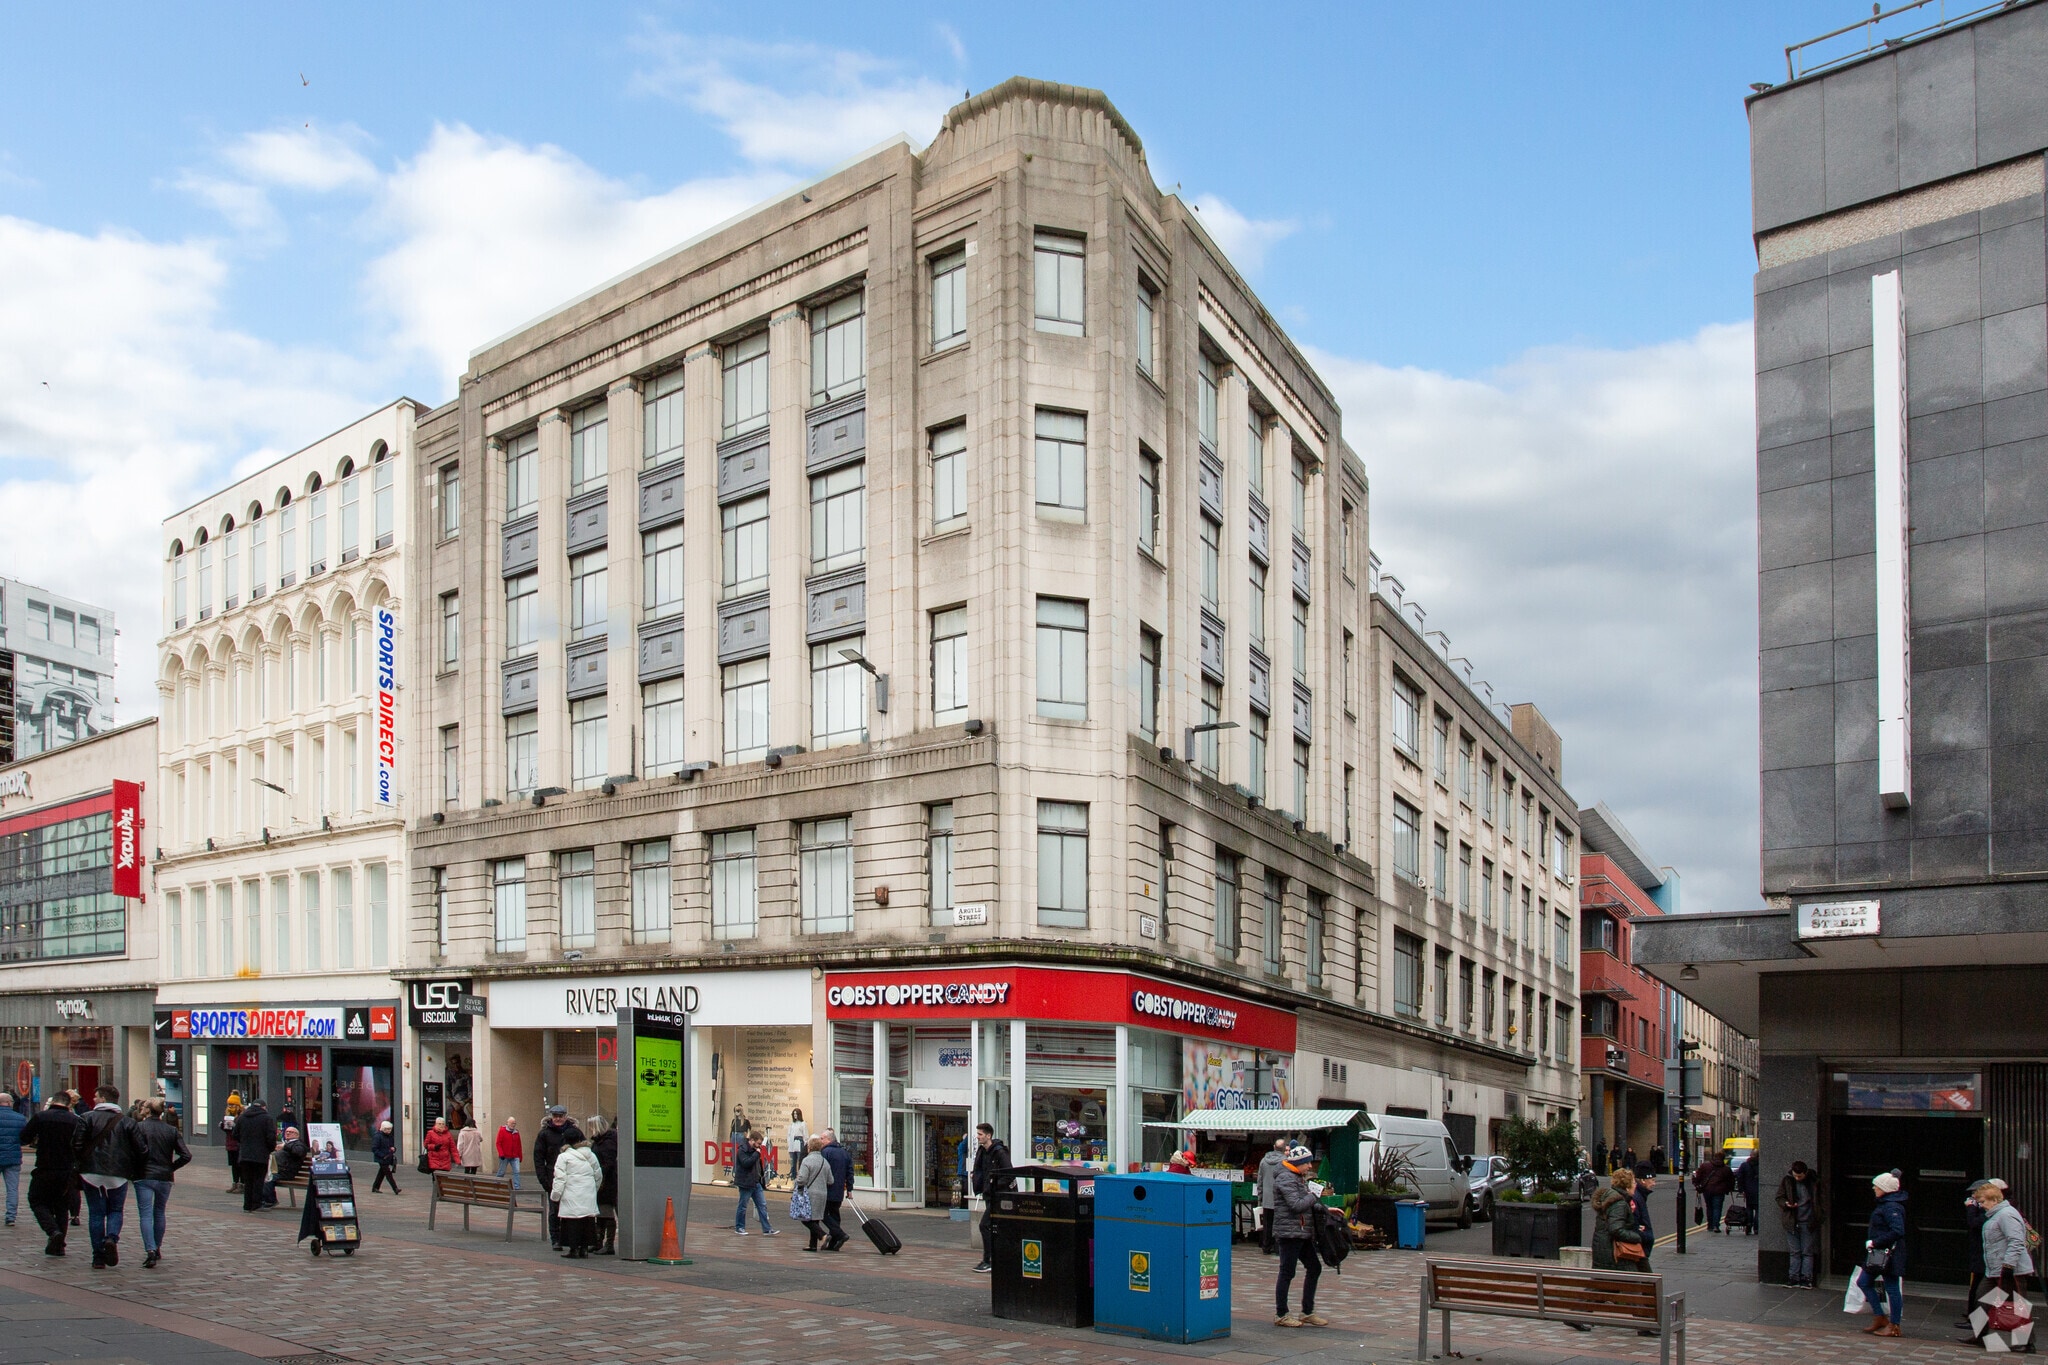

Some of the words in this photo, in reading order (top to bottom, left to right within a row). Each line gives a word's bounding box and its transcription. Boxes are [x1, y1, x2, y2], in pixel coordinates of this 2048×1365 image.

[1811, 906, 1867, 918] ARGYLE
[1811, 918, 1866, 929] STREET
[413, 982, 463, 1009] USC
[565, 987, 618, 1015] RIVER
[627, 986, 700, 1012] ISLAND
[828, 984, 944, 1007] GOBSTOPPER
[944, 982, 1010, 1005] CANDY
[466, 998, 482, 1006] RIVER
[464, 1004, 484, 1013] ISLAND
[1134, 990, 1206, 1025] GOBSTOPPER
[1205, 1005, 1238, 1030] CANDY
[190, 1009, 336, 1037] SPORTSDIRECT.COM
[422, 1011, 457, 1024] USC.CO.UK
[641, 1057, 656, 1067] THE
[659, 1059, 677, 1068] 1975
[769, 1065, 794, 1073] authenticity
